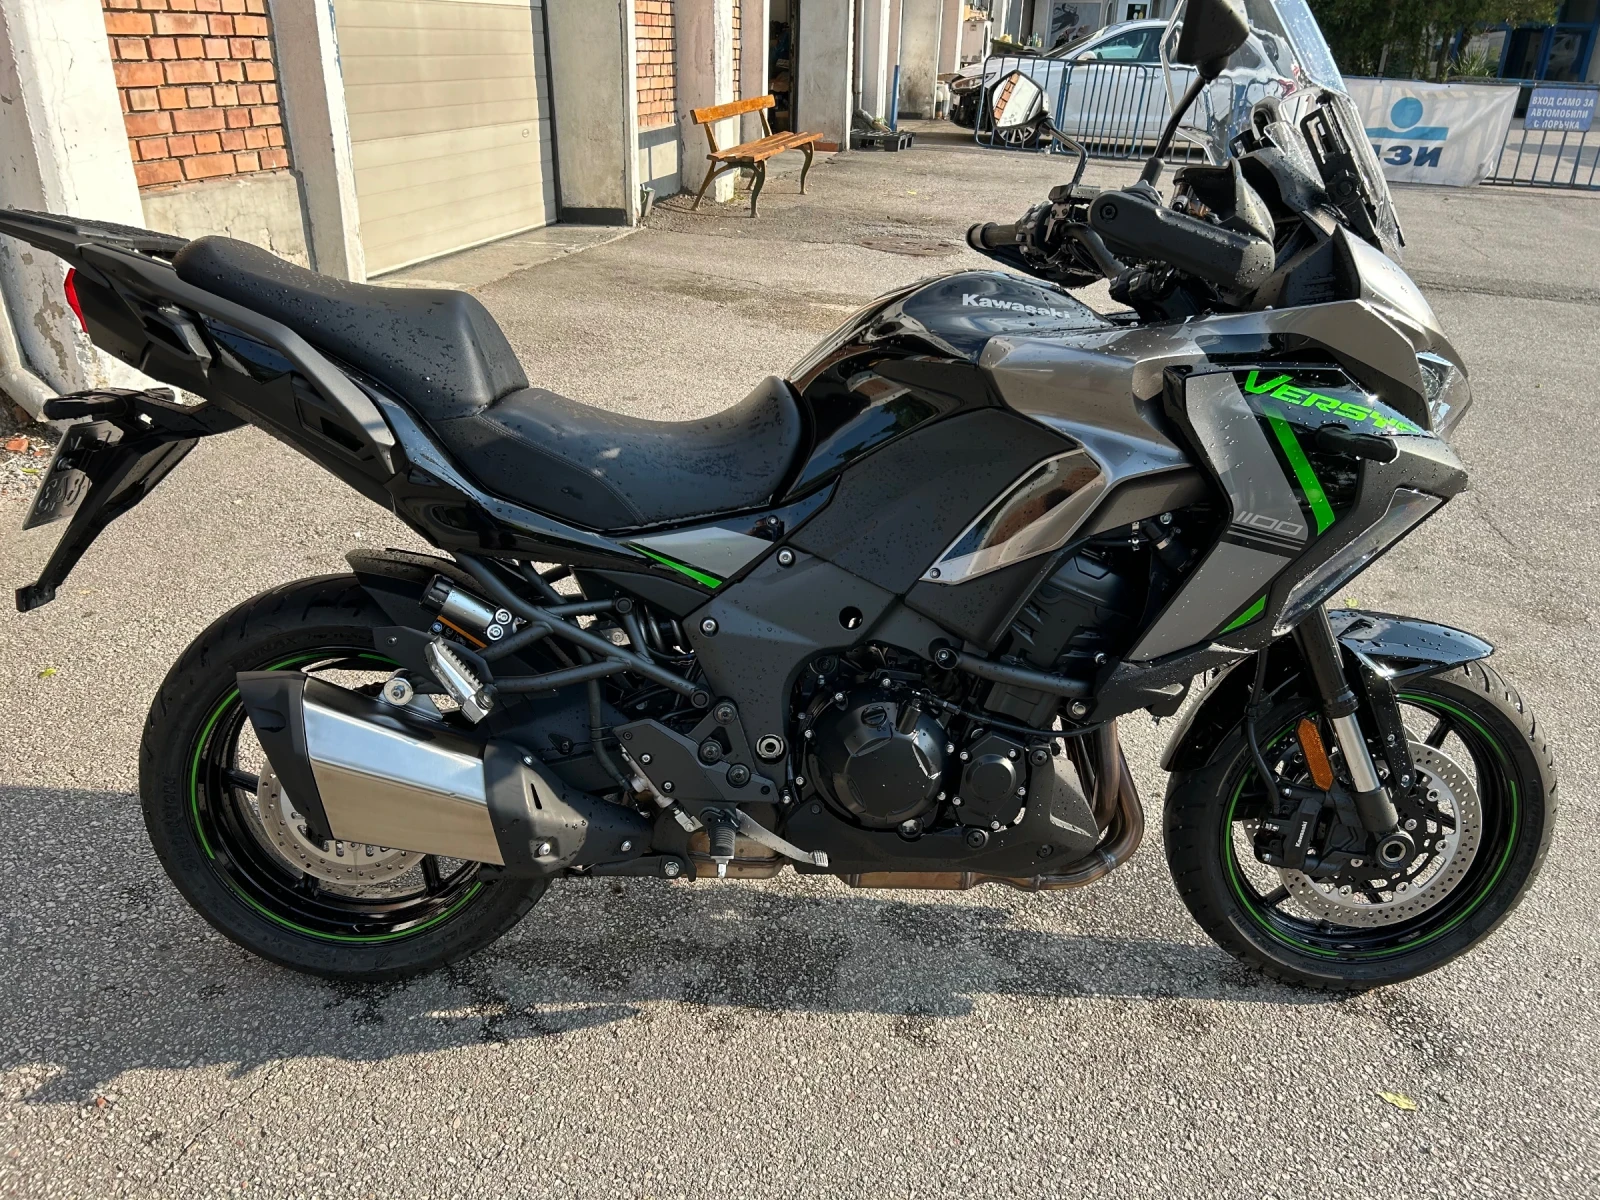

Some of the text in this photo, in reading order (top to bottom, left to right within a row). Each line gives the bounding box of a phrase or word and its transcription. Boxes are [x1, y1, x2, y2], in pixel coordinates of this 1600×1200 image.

[1531, 96, 1594, 107] ВХОД САМО ЗА
[1530, 108, 1589, 118] АВТОМОБИЛИ
[1533, 119, 1580, 129] С ПОРЪЧКА
[962, 293, 1071, 319] Kawasaki
[1235, 511, 1304, 536] 1100
[1294, 821, 1308, 848] Kawasaki
